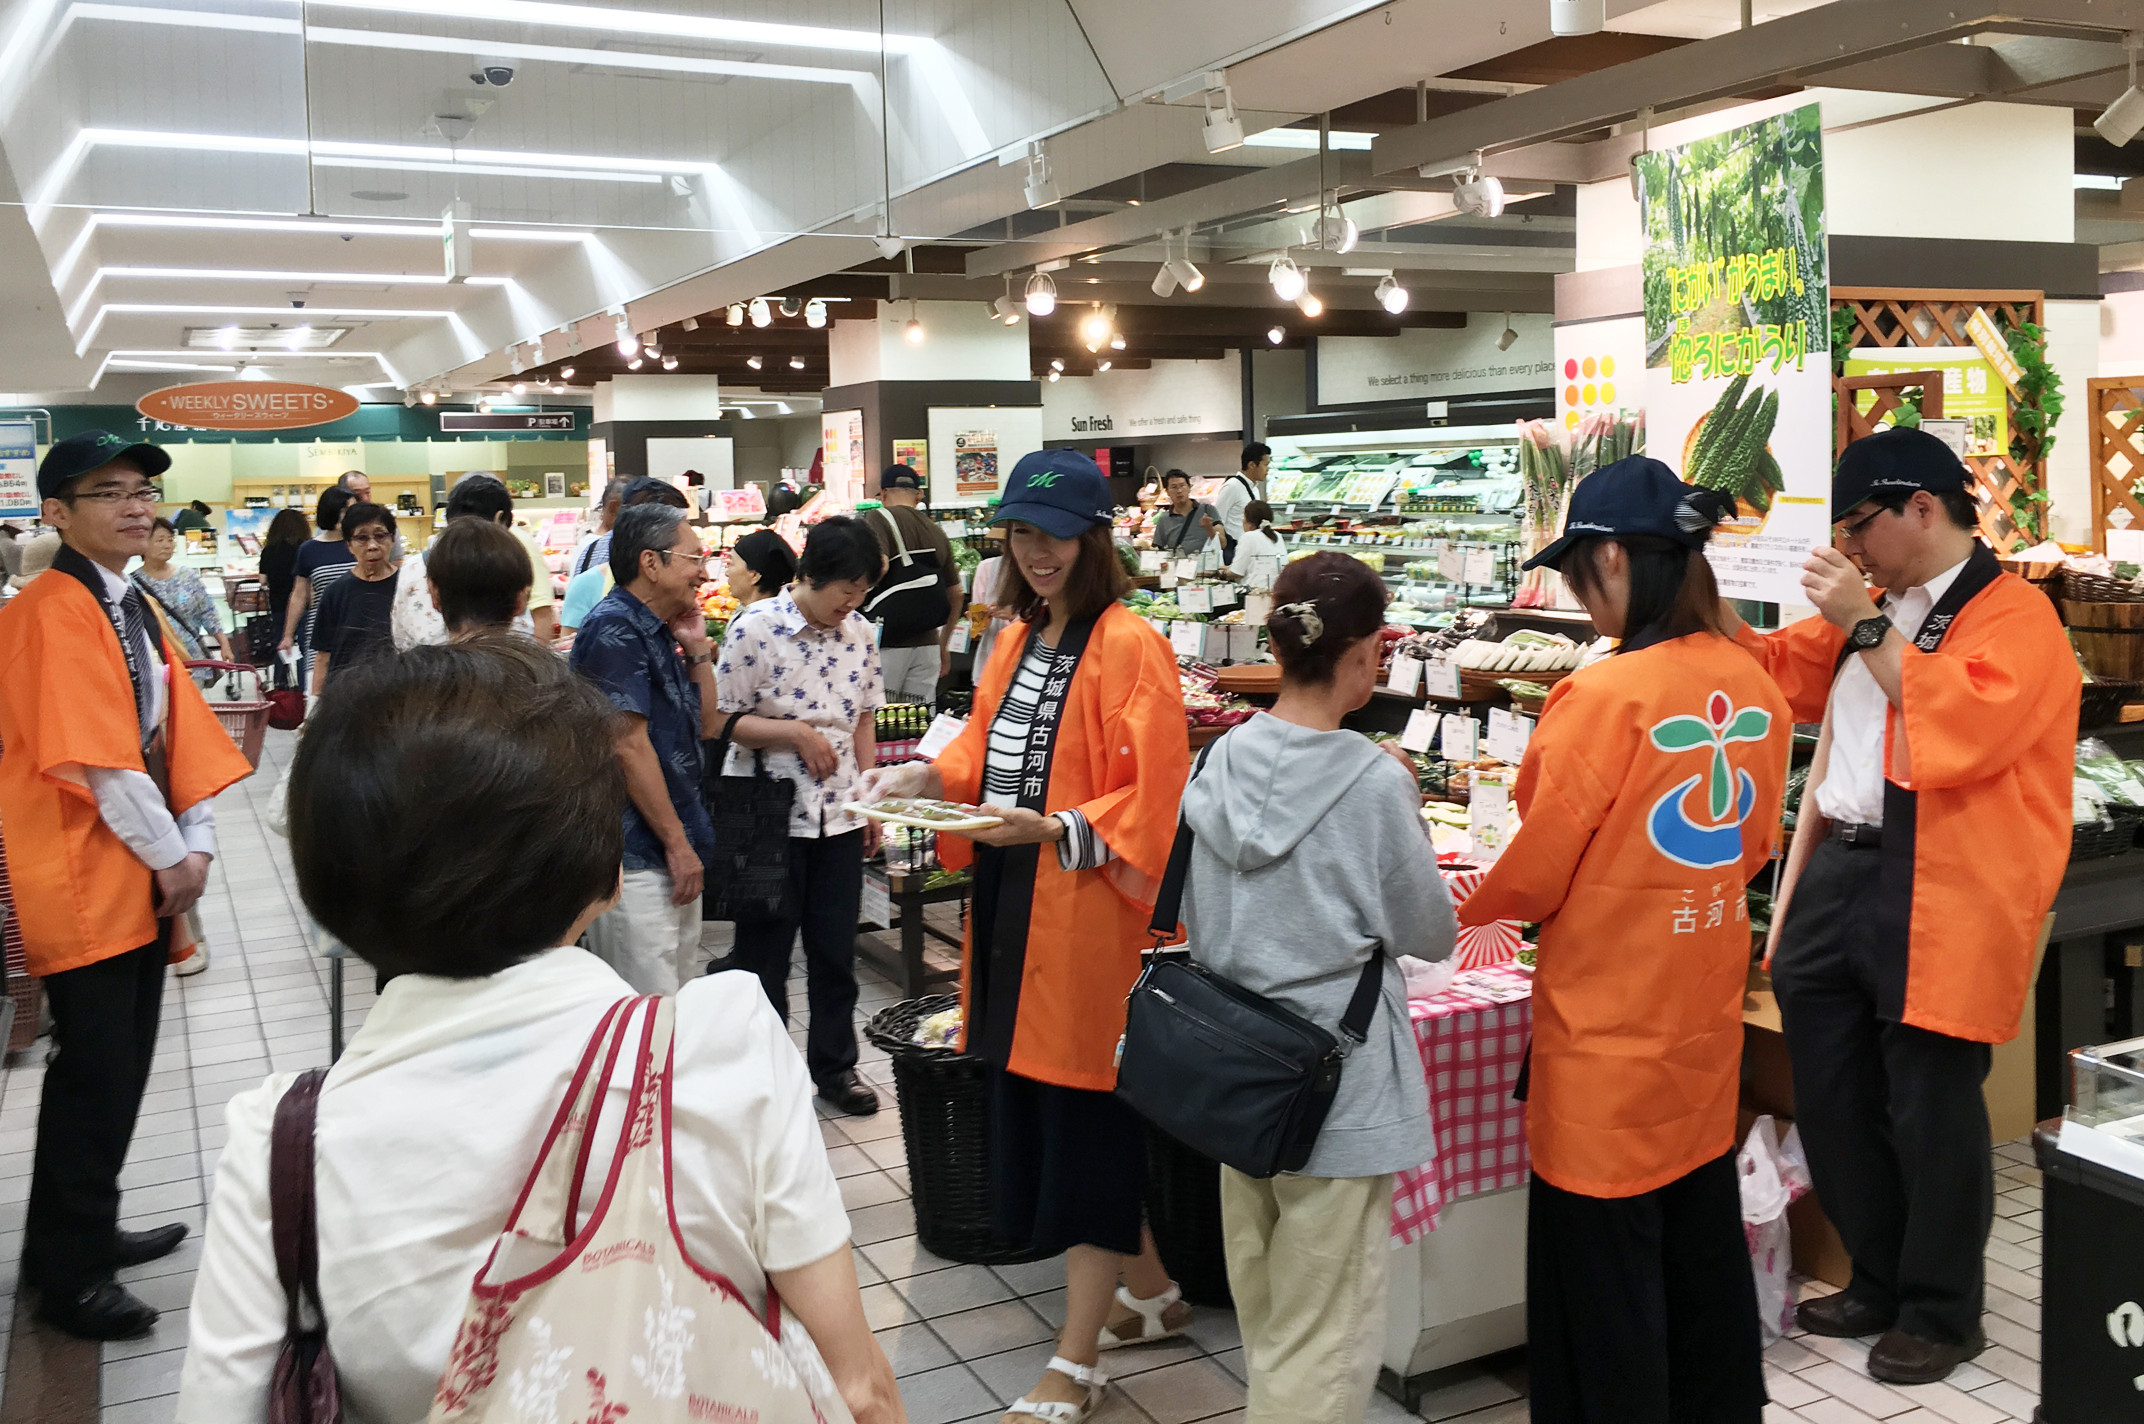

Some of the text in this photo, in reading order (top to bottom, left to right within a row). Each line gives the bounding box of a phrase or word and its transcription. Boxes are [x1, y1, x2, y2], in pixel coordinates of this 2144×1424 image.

[1380, 374, 1403, 386] select
[1409, 372, 1429, 385] thing
[1430, 371, 1451, 382] more
[1452, 368, 1487, 381] delicious
[1488, 365, 1508, 376] than
[1509, 363, 1534, 376] every
[169, 393, 328, 410] WEEKLY SWEETS
[1071, 415, 1114, 432] Sun Fresh
[1023, 654, 1077, 798] 茨城県古河市
